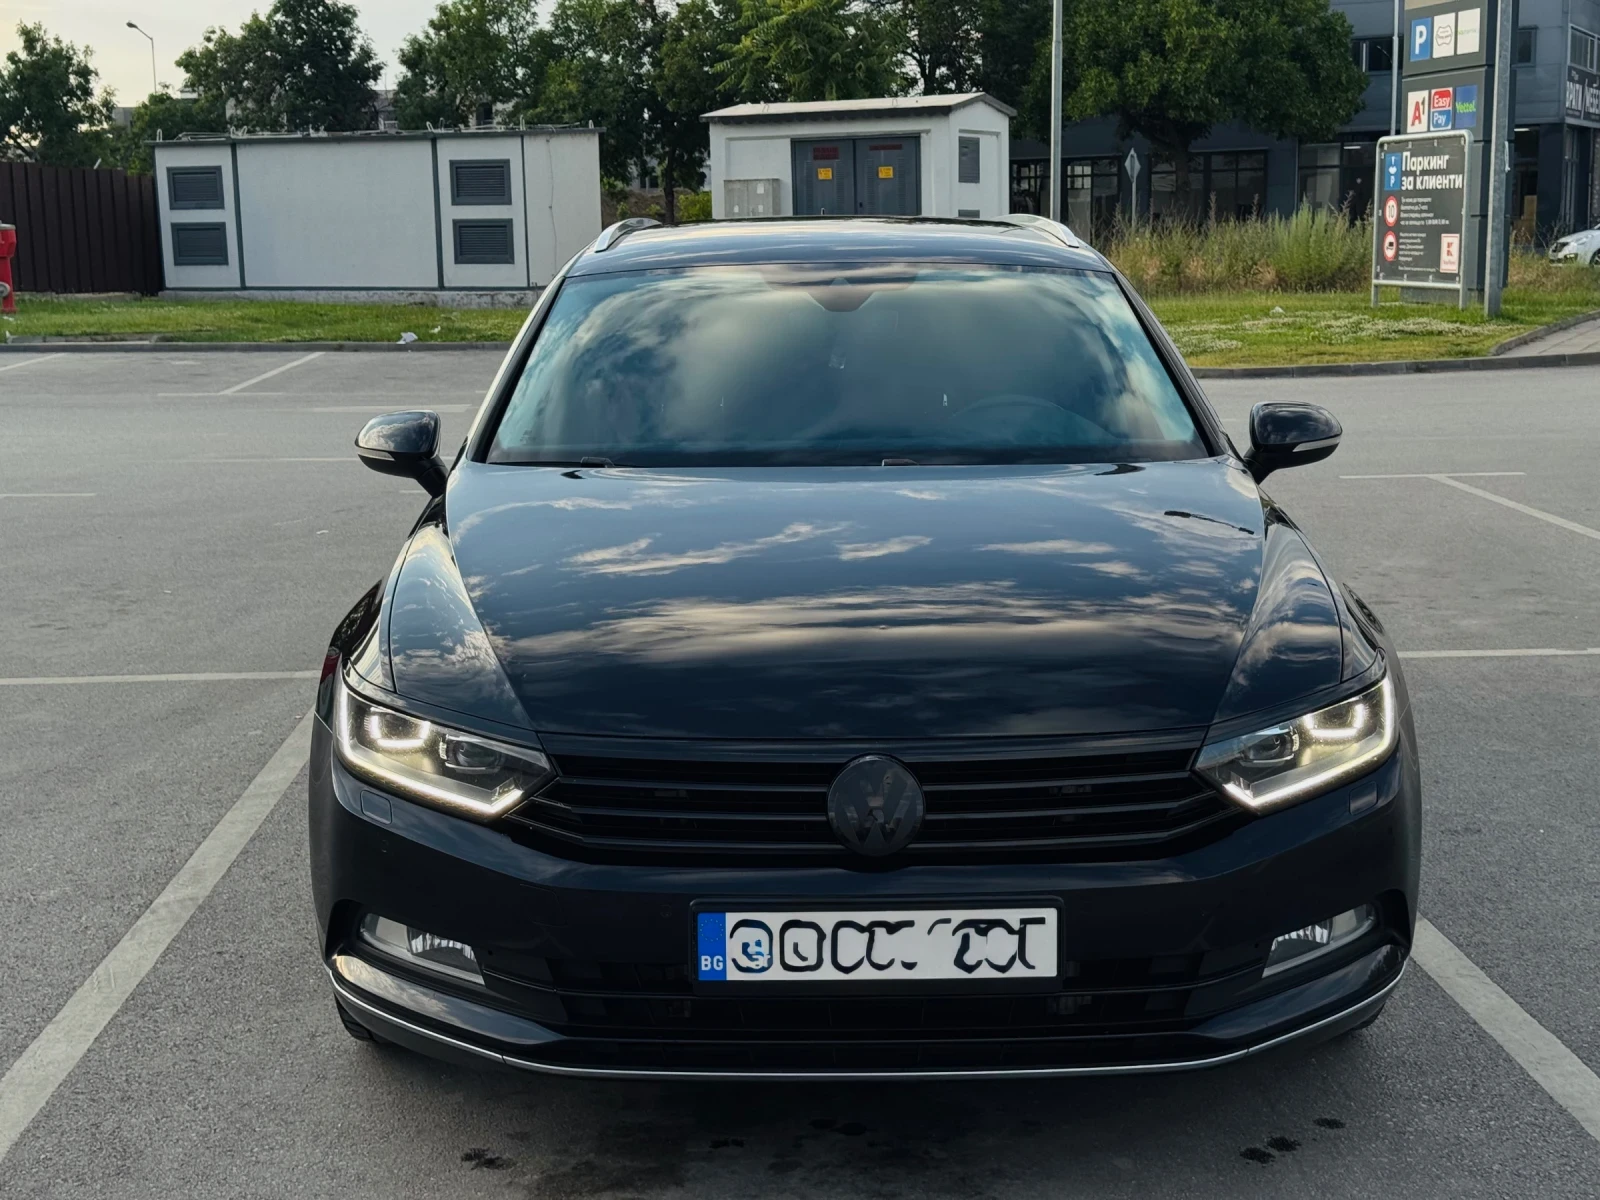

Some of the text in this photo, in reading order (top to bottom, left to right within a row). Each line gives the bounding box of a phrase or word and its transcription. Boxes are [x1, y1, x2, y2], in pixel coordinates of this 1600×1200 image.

[1415, 25, 1427, 55] P
[1433, 95, 1450, 109] Easy
[1410, 96, 1425, 127] A1
[1433, 112, 1447, 126] Pay
[1402, 151, 1450, 176] Паркинг
[1401, 174, 1463, 190] за клиенти
[701, 955, 724, 971] BG
